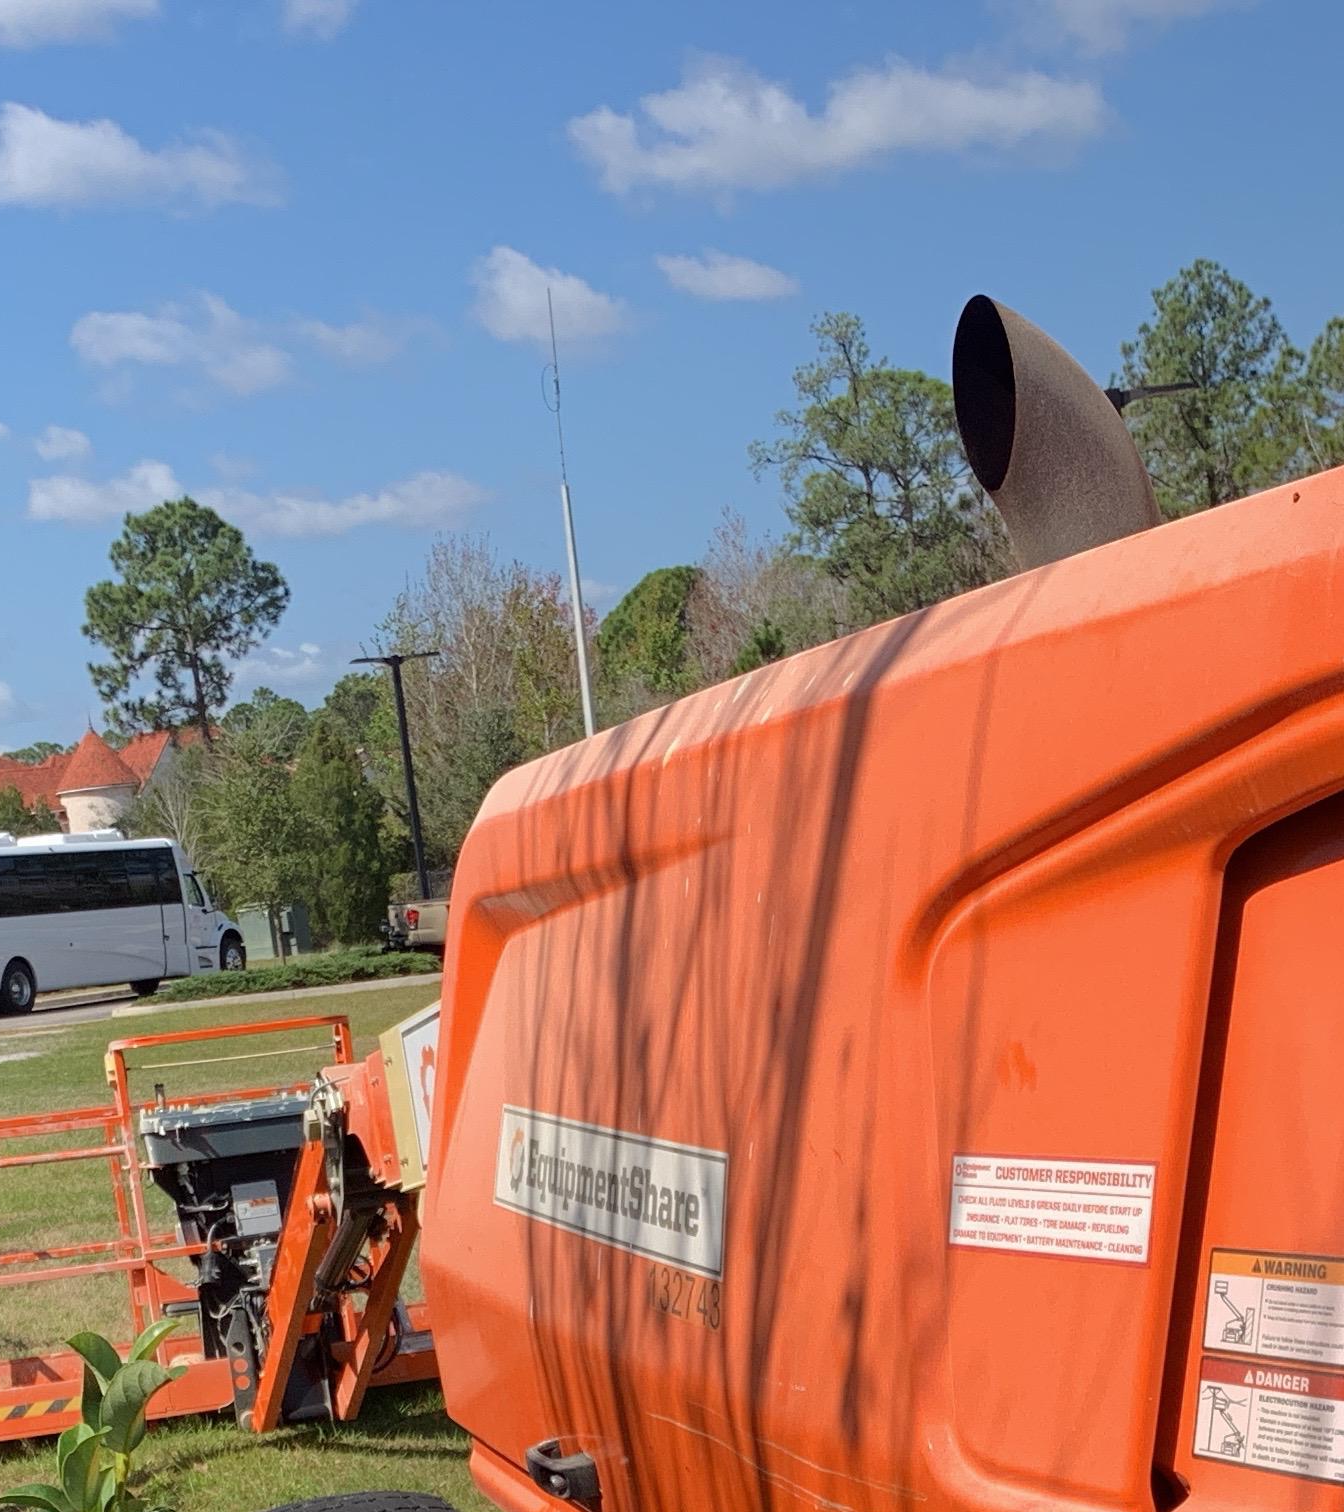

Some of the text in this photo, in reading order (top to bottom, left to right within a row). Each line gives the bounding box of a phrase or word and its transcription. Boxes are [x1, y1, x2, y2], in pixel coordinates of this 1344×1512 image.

[527, 1139, 699, 1237] EquipmentShare
[996, 1166, 1152, 1188] CUSTOMER RESPONSIBILITY
[958, 1195, 977, 1204] CHECK
[978, 1196, 988, 1205] ALL
[1008, 1198, 1029, 1208] LEVELS
[1037, 1200, 1061, 1211] GREASE
[1063, 1202, 1081, 1213] DAILY
[1082, 1204, 1108, 1215] BEFORE
[1110, 1205, 1131, 1216] START
[1133, 1207, 1142, 1216] UP
[967, 1212, 1129, 1235] INSURANCE FLAT TIRES TIRE DAMAGE REFUELING
[987, 1231, 1023, 1243] EQUIPMENT
[1026, 1235, 1055, 1246] BATTERY
[1055, 1238, 1103, 1251] MAINTENANCE
[1108, 1243, 1143, 1255] CLEANING
[1264, 1259, 1327, 1279] WARNING
[649, 1264, 720, 1330] 132743
[1255, 1371, 1310, 1392] DANGER
